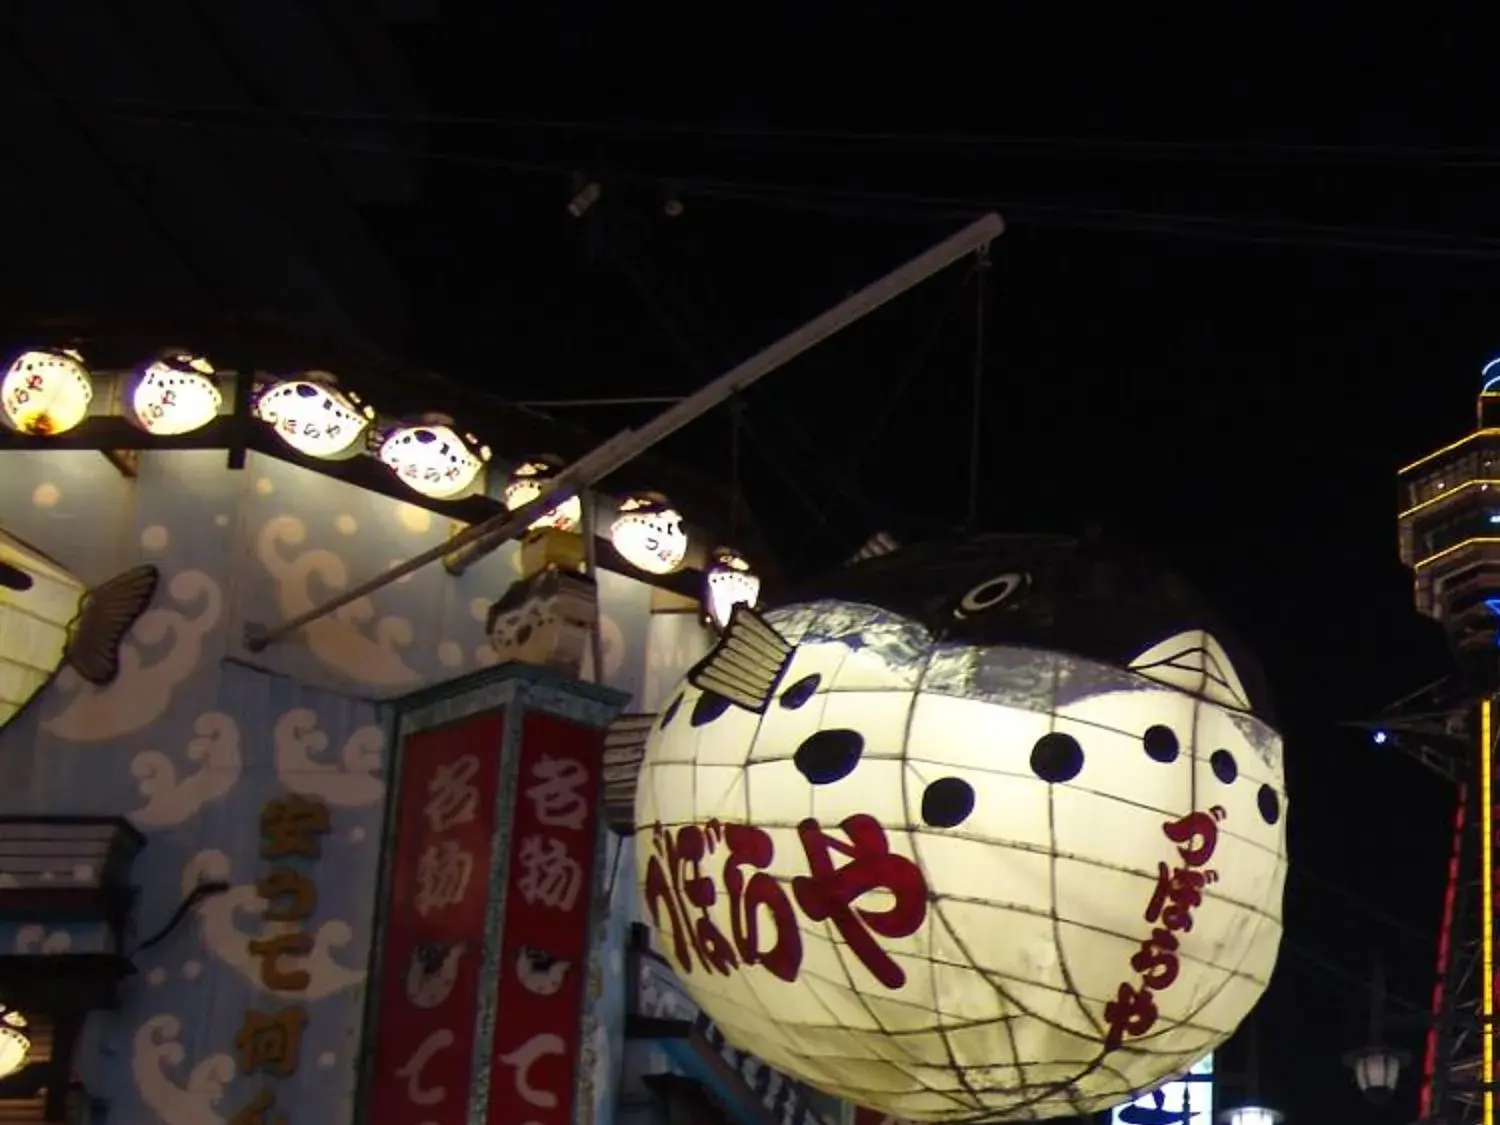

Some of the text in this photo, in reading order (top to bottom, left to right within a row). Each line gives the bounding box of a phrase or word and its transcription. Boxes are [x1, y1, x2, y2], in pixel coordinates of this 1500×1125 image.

[424, 752, 480, 919] 名物
[517, 752, 590, 912] 名物
[1104, 804, 1226, 1051] づぼらや
